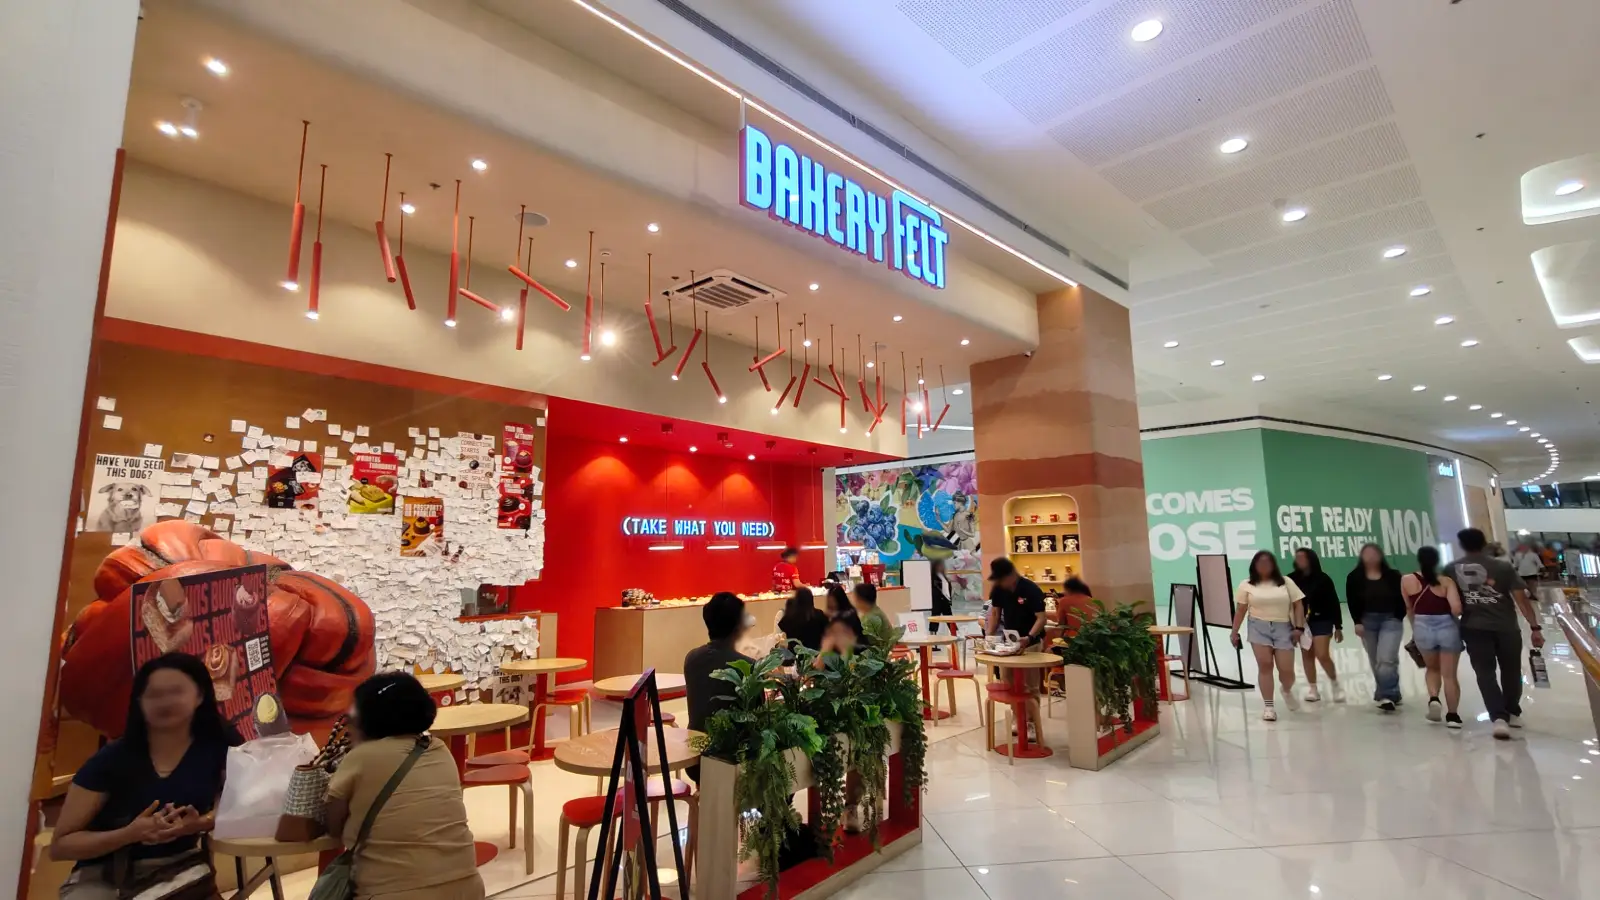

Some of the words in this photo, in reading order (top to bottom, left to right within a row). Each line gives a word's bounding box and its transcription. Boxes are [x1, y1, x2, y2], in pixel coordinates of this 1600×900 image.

[745, 124, 887, 262] BAKERY
[892, 190, 948, 289] FELT
[96, 455, 120, 466] HAVE
[124, 458, 140, 468] YOU
[143, 459, 164, 470] SEEN
[107, 467, 126, 478] THIS
[130, 469, 153, 479] DOG?
[1146, 488, 1254, 515] COMES
[623, 516, 667, 535] (TAKE
[674, 519, 706, 535] WHAT
[714, 521, 736, 536] YOU
[742, 522, 775, 537] NEED)
[1277, 505, 1313, 532] GET
[1321, 506, 1373, 532] READY
[1379, 509, 1437, 556] MOA
[1316, 536, 1346, 558] THE
[251, 667, 276, 697] BUNS
